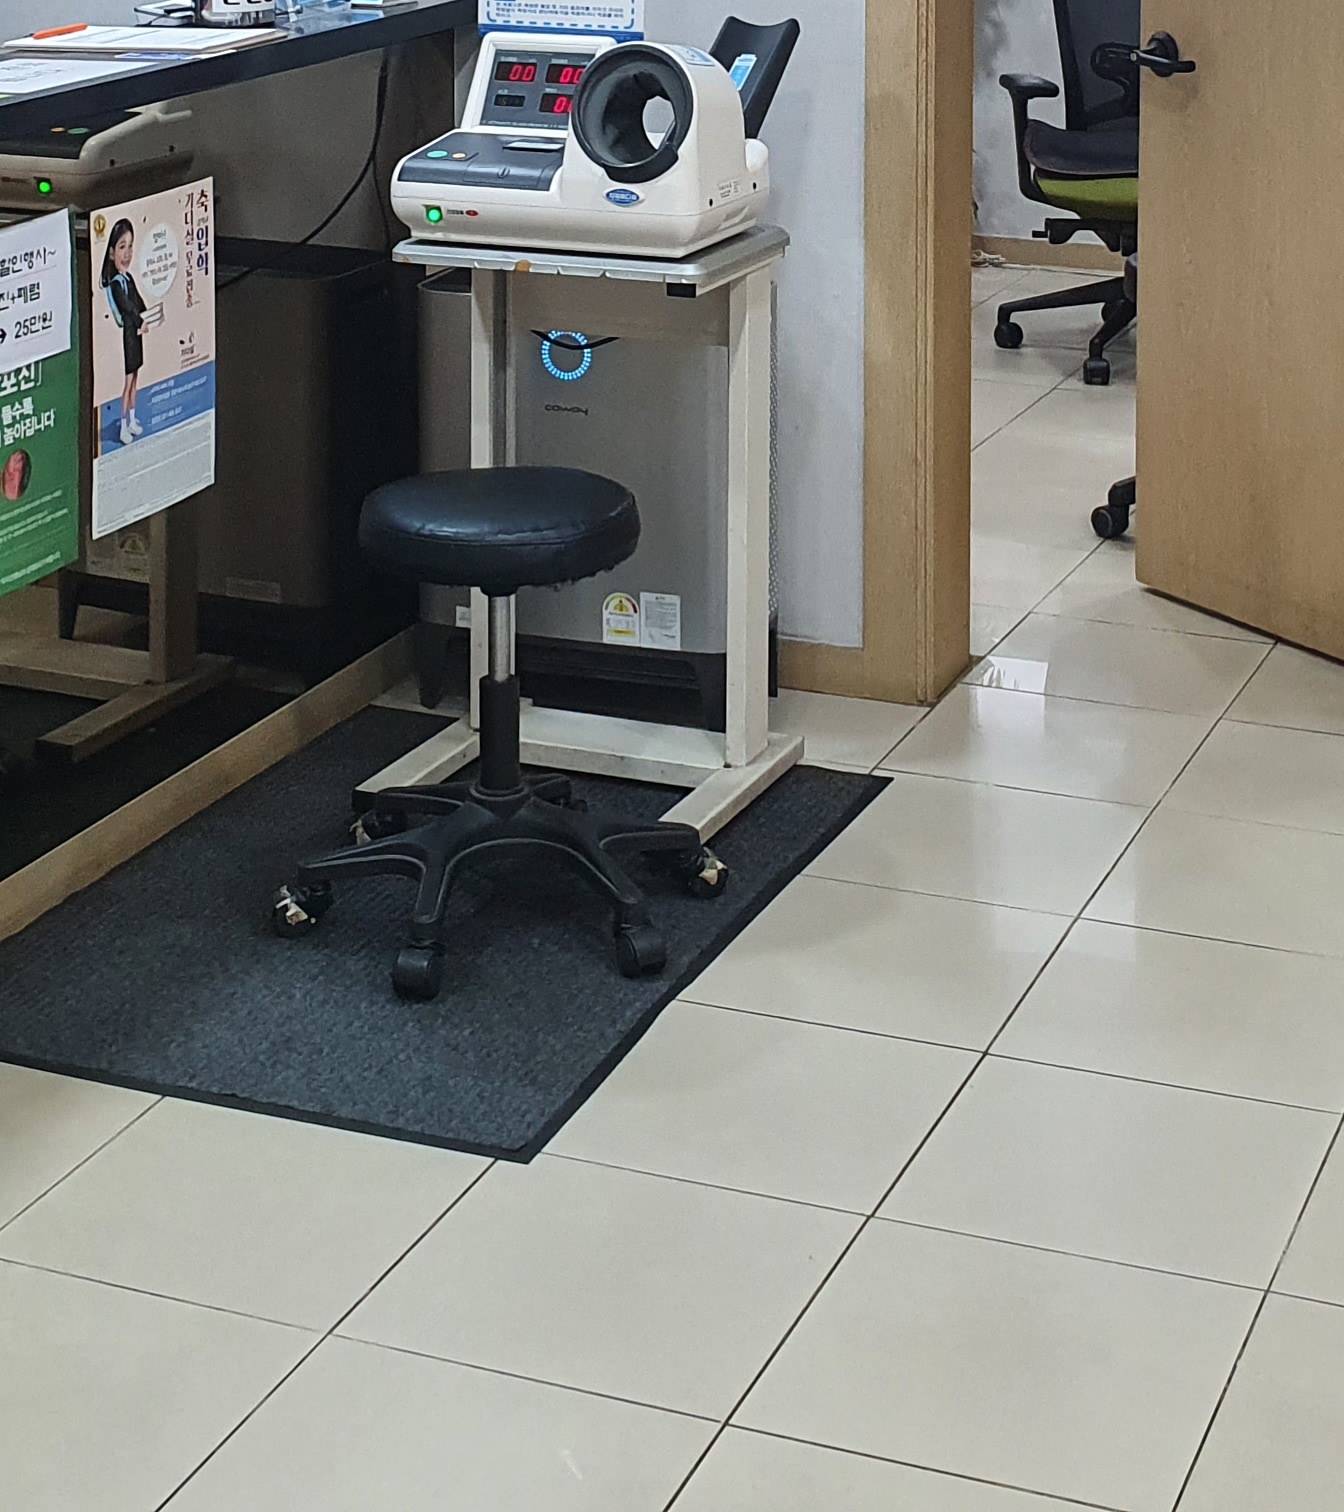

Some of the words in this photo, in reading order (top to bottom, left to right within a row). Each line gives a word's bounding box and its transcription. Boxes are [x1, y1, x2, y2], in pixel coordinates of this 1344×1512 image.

[14, 310, 53, 339] 25만원
[544, 403, 589, 416] coway
[3, 408, 56, 446] 높아집니다
